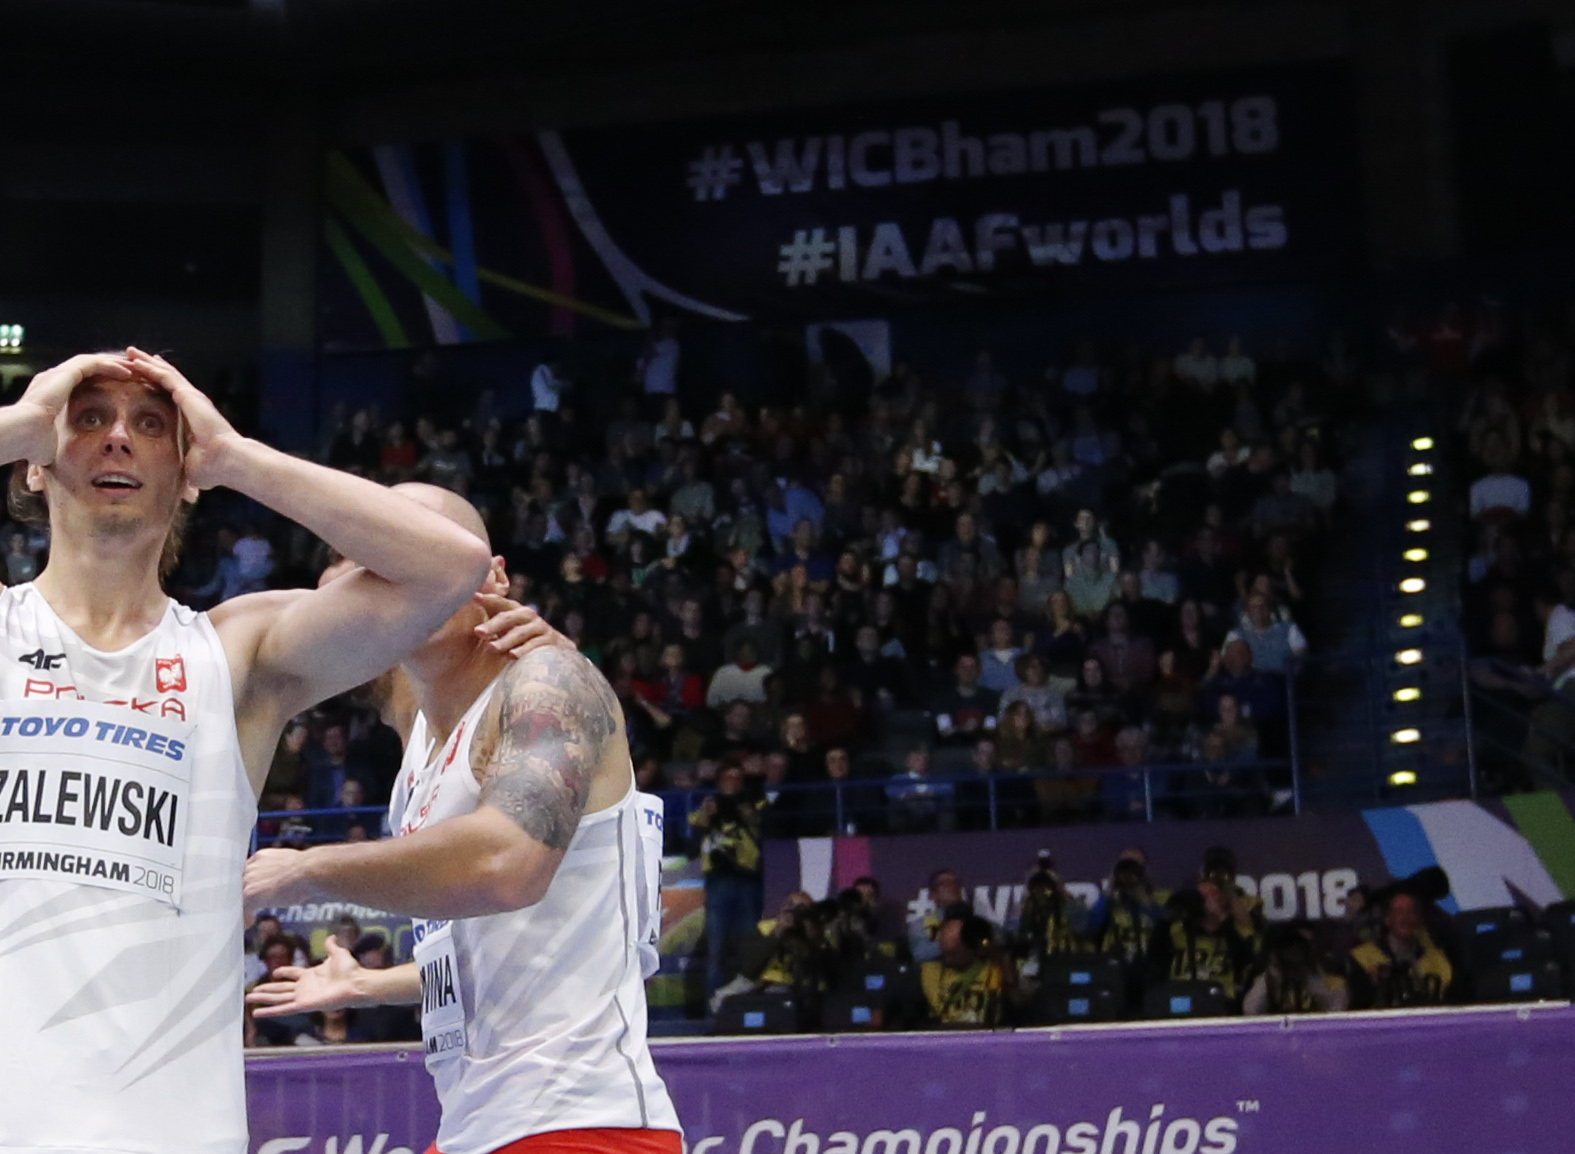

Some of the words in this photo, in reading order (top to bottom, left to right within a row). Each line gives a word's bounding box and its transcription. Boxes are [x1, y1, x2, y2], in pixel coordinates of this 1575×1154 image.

[686, 95, 1279, 201] #WICBham2018
[777, 190, 1289, 286] #IAAFworlds
[1, 716, 89, 737] TOYO
[95, 720, 186, 761] TIRES
[133, 866, 174, 895] 2018
